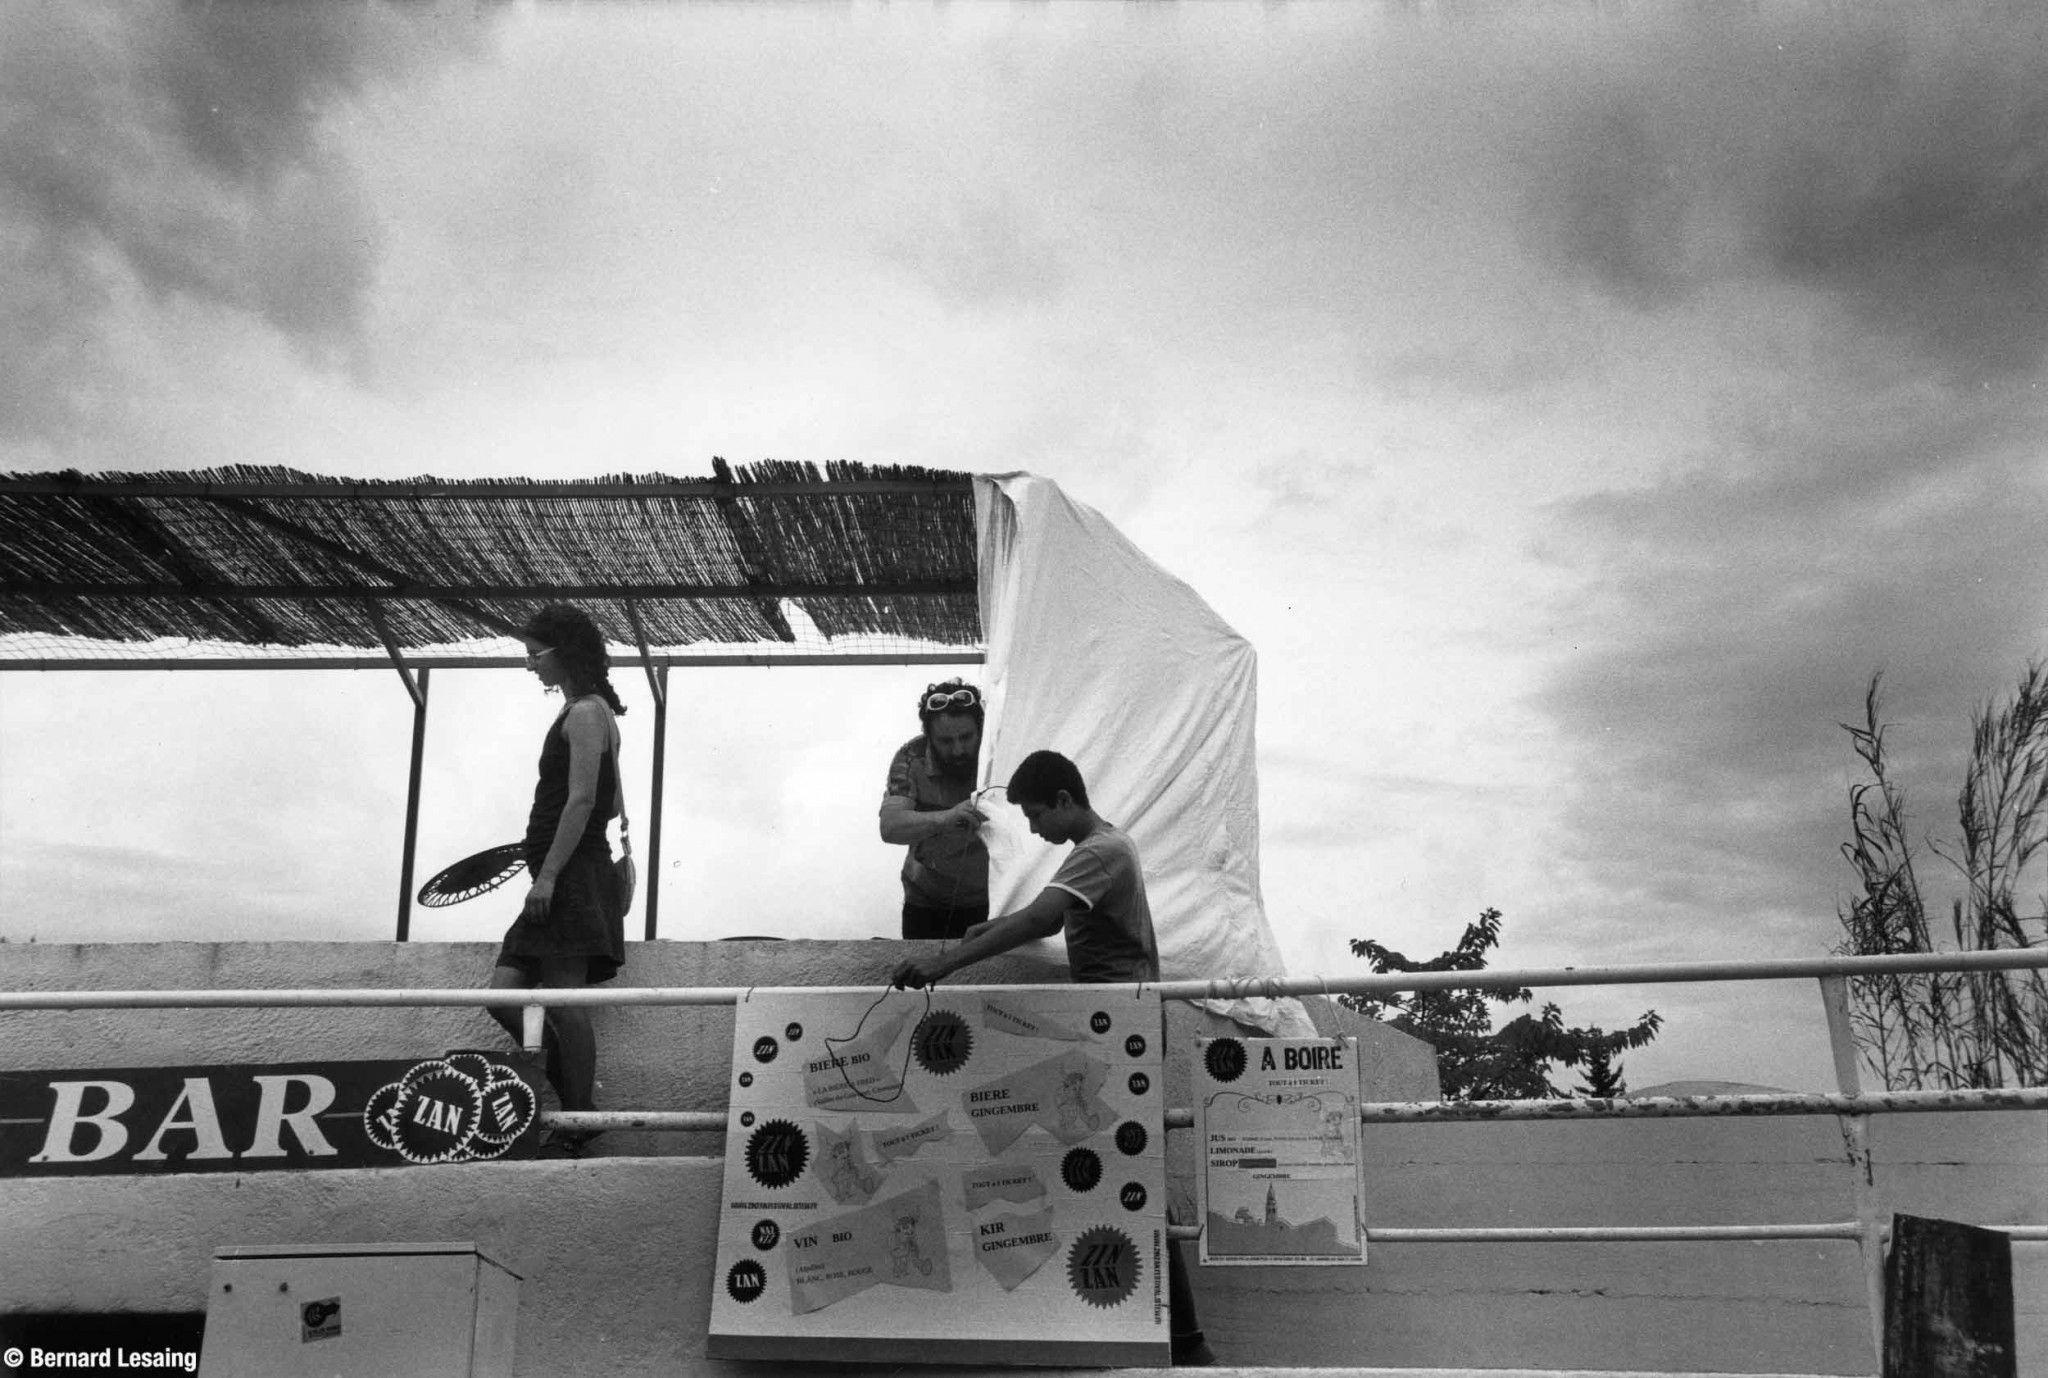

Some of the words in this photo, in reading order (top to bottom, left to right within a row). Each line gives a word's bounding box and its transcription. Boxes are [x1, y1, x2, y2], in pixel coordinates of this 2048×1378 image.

[809, 1056, 849, 1073] BIERE
[851, 1052, 871, 1065] BIO
[1261, 1046, 1276, 1071] A
[1284, 1046, 1343, 1071] BOIRE
[970, 1088, 1010, 1103] BIERE
[28, 1074, 339, 1163] BAR
[413, 1095, 464, 1136] ZAN
[491, 1091, 518, 1132] ZAN
[971, 1103, 1040, 1118] GINGEMBRE
[1210, 1159, 1239, 1167] SIROP
[980, 1222, 1005, 1236] KIR
[793, 1235, 818, 1249] VIN
[832, 1231, 853, 1243] BIO
[982, 1232, 1053, 1252] GINGEMBRE
[1080, 1244, 1125, 1267] ZIN
[734, 1273, 760, 1288] ZAN
[1079, 1267, 1120, 1290] ZAN
